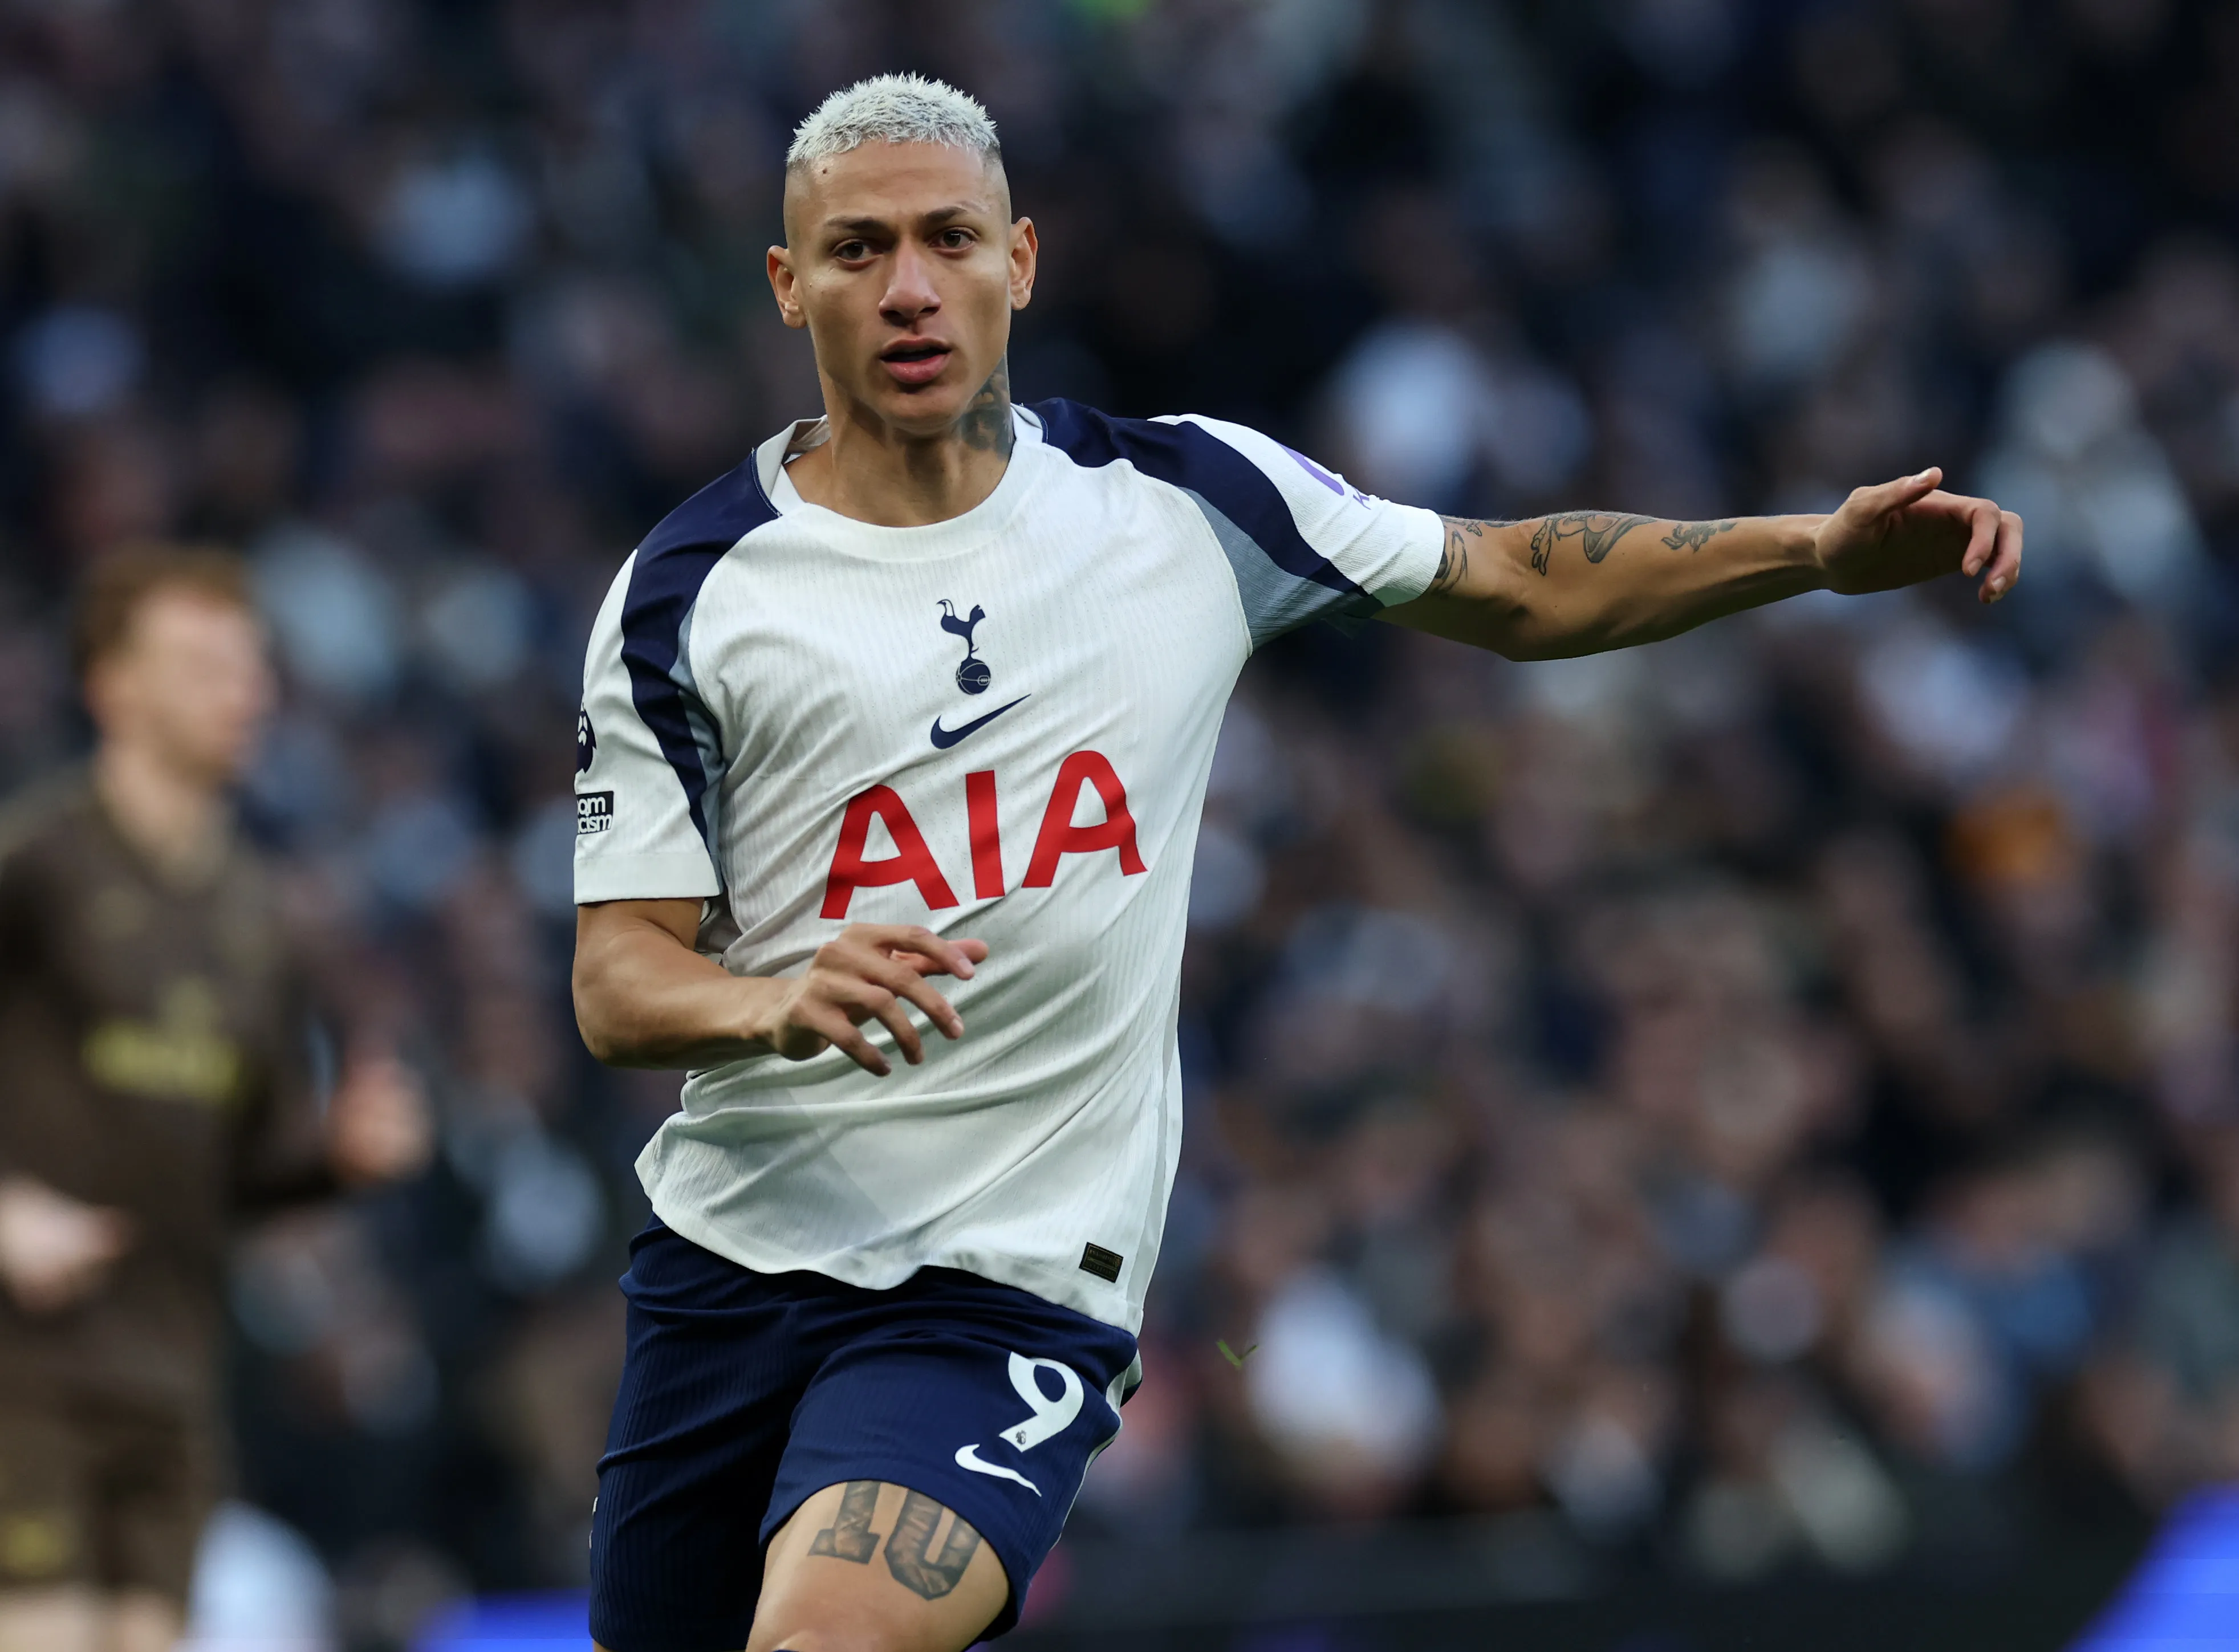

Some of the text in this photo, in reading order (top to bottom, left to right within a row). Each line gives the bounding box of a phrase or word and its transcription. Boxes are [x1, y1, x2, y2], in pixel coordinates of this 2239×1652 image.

[576, 796, 606, 815] om
[577, 814, 612, 834] cism
[819, 750, 1148, 919] AIA
[998, 1351, 1084, 1453] 9
